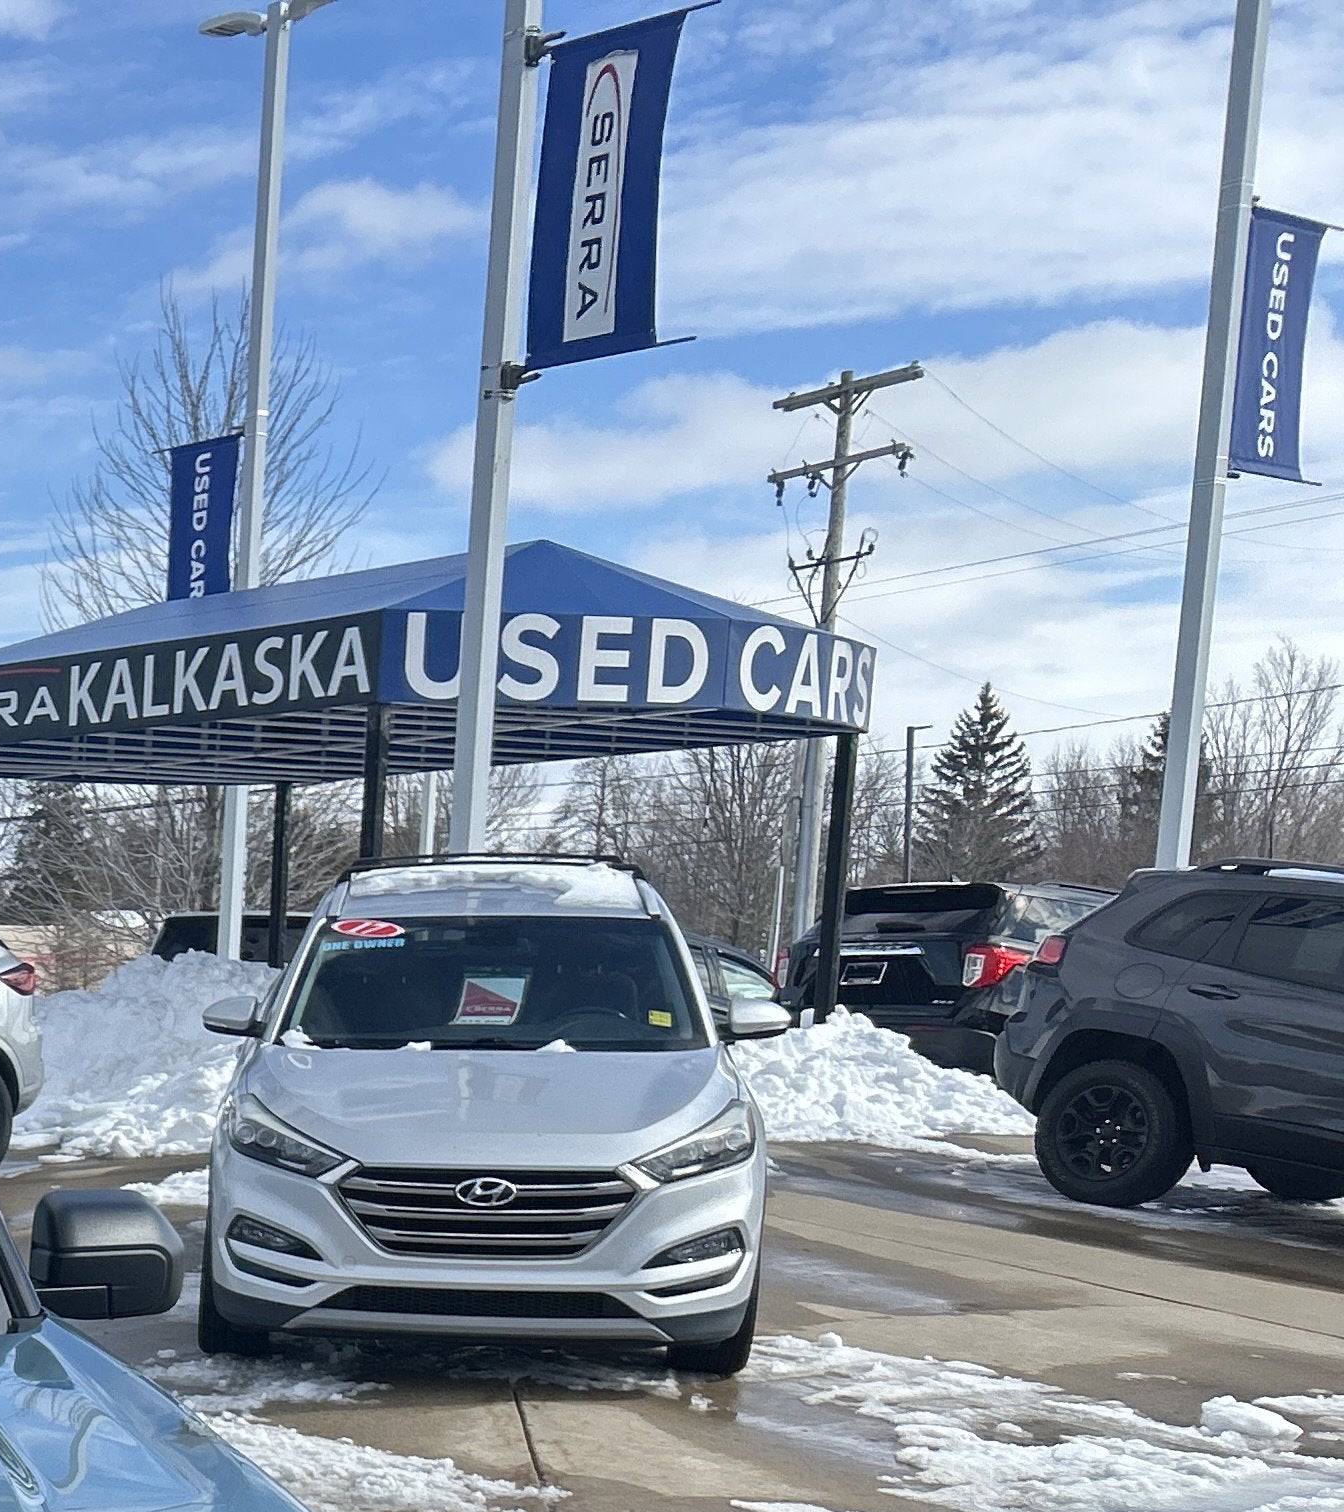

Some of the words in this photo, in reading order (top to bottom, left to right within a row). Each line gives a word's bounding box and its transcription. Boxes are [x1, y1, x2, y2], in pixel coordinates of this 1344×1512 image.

[575, 111, 614, 321] SERRA
[1265, 232, 1295, 341] USED
[1257, 351, 1279, 458] CARS
[192, 452, 212, 532] USED
[189, 539, 207, 599] CAR
[68, 626, 370, 726] KALKASKA
[404, 612, 709, 703] USED
[739, 624, 873, 728] CARS
[323, 941, 351, 951] ONE
[354, 938, 405, 949] OWNER
